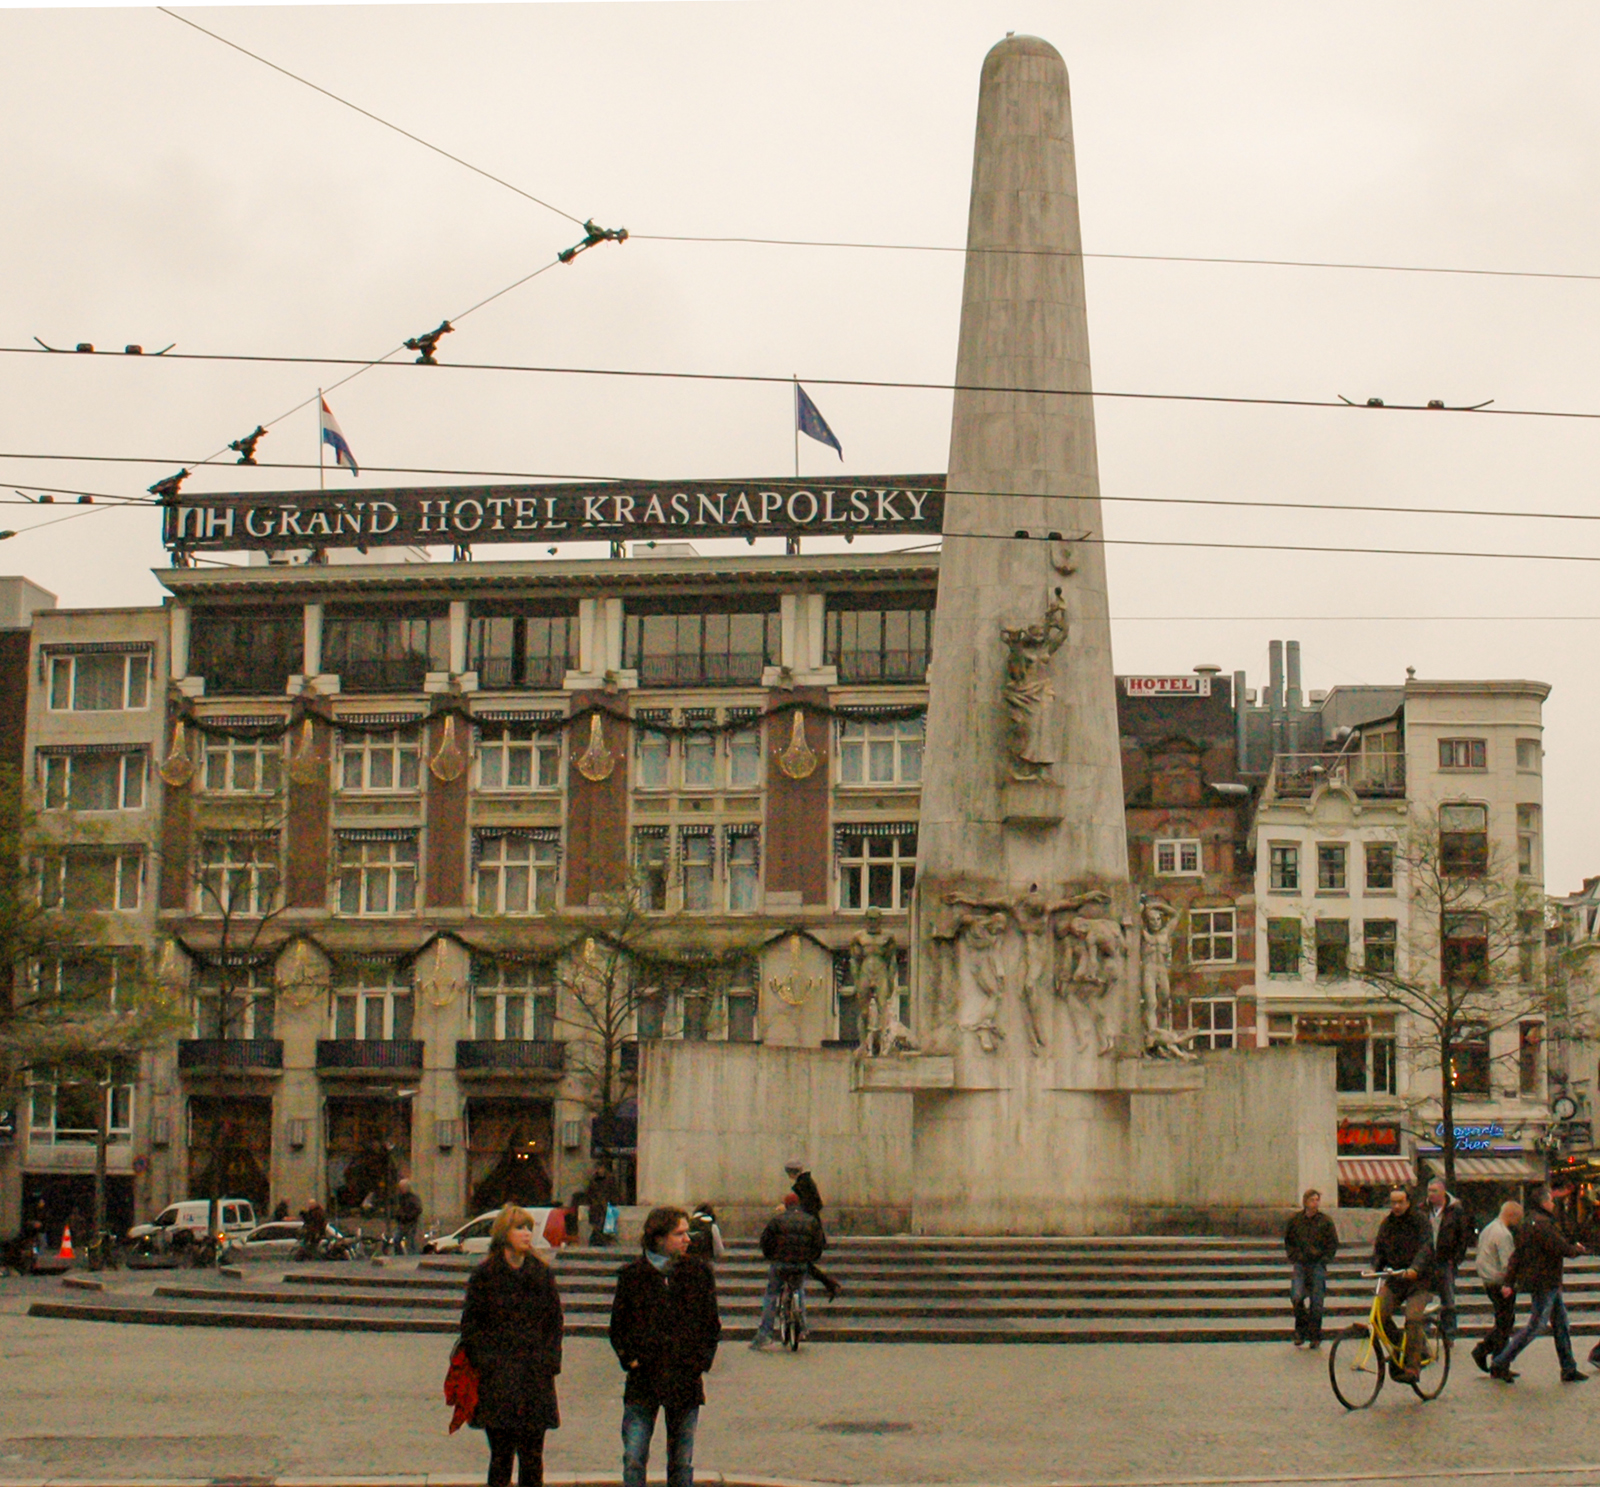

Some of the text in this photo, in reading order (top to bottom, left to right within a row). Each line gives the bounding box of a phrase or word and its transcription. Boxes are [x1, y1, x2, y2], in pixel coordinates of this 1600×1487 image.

[245, 501, 399, 538] GRAND
[417, 497, 568, 532] HOTEL
[581, 490, 928, 528] KRASNAPOLSKY
[1129, 678, 1193, 690] HOTEL
